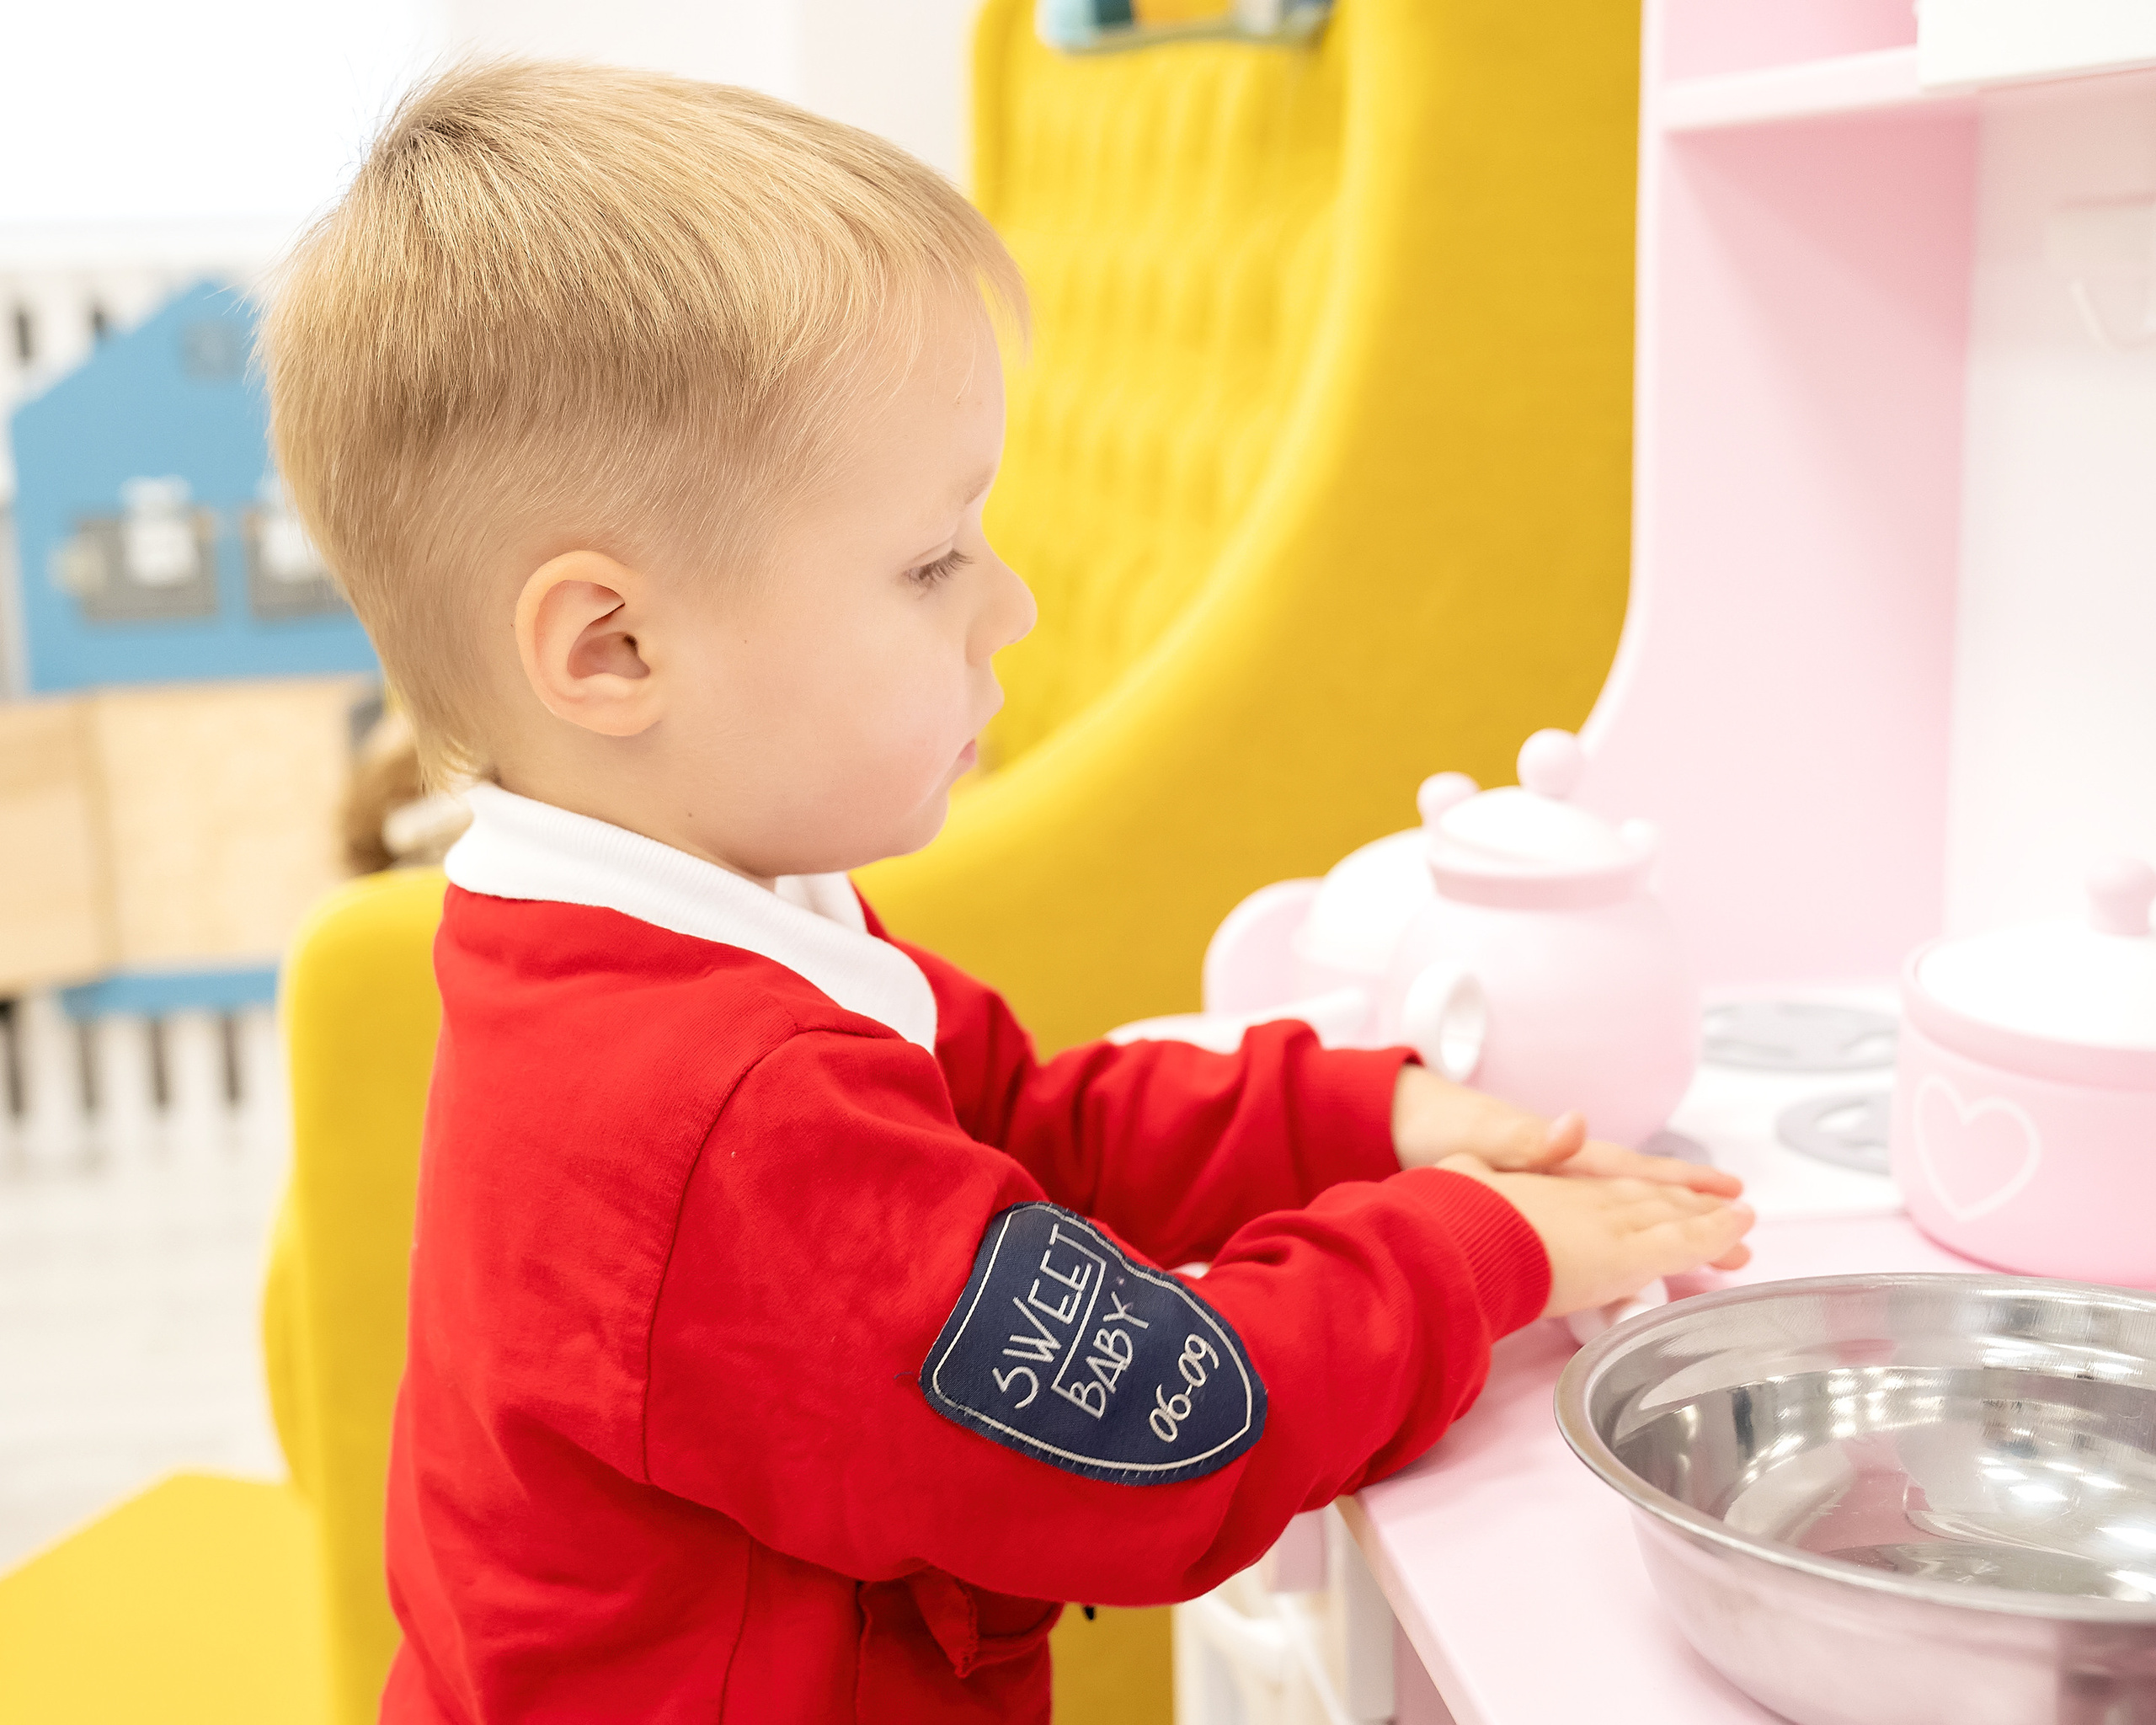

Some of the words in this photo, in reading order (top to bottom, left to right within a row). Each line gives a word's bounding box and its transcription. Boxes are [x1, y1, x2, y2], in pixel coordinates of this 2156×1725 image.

[992, 1223, 1106, 1409] SWEET
[1051, 1291, 1149, 1419] BABY
[1149, 1333, 1219, 1443] 06-09
